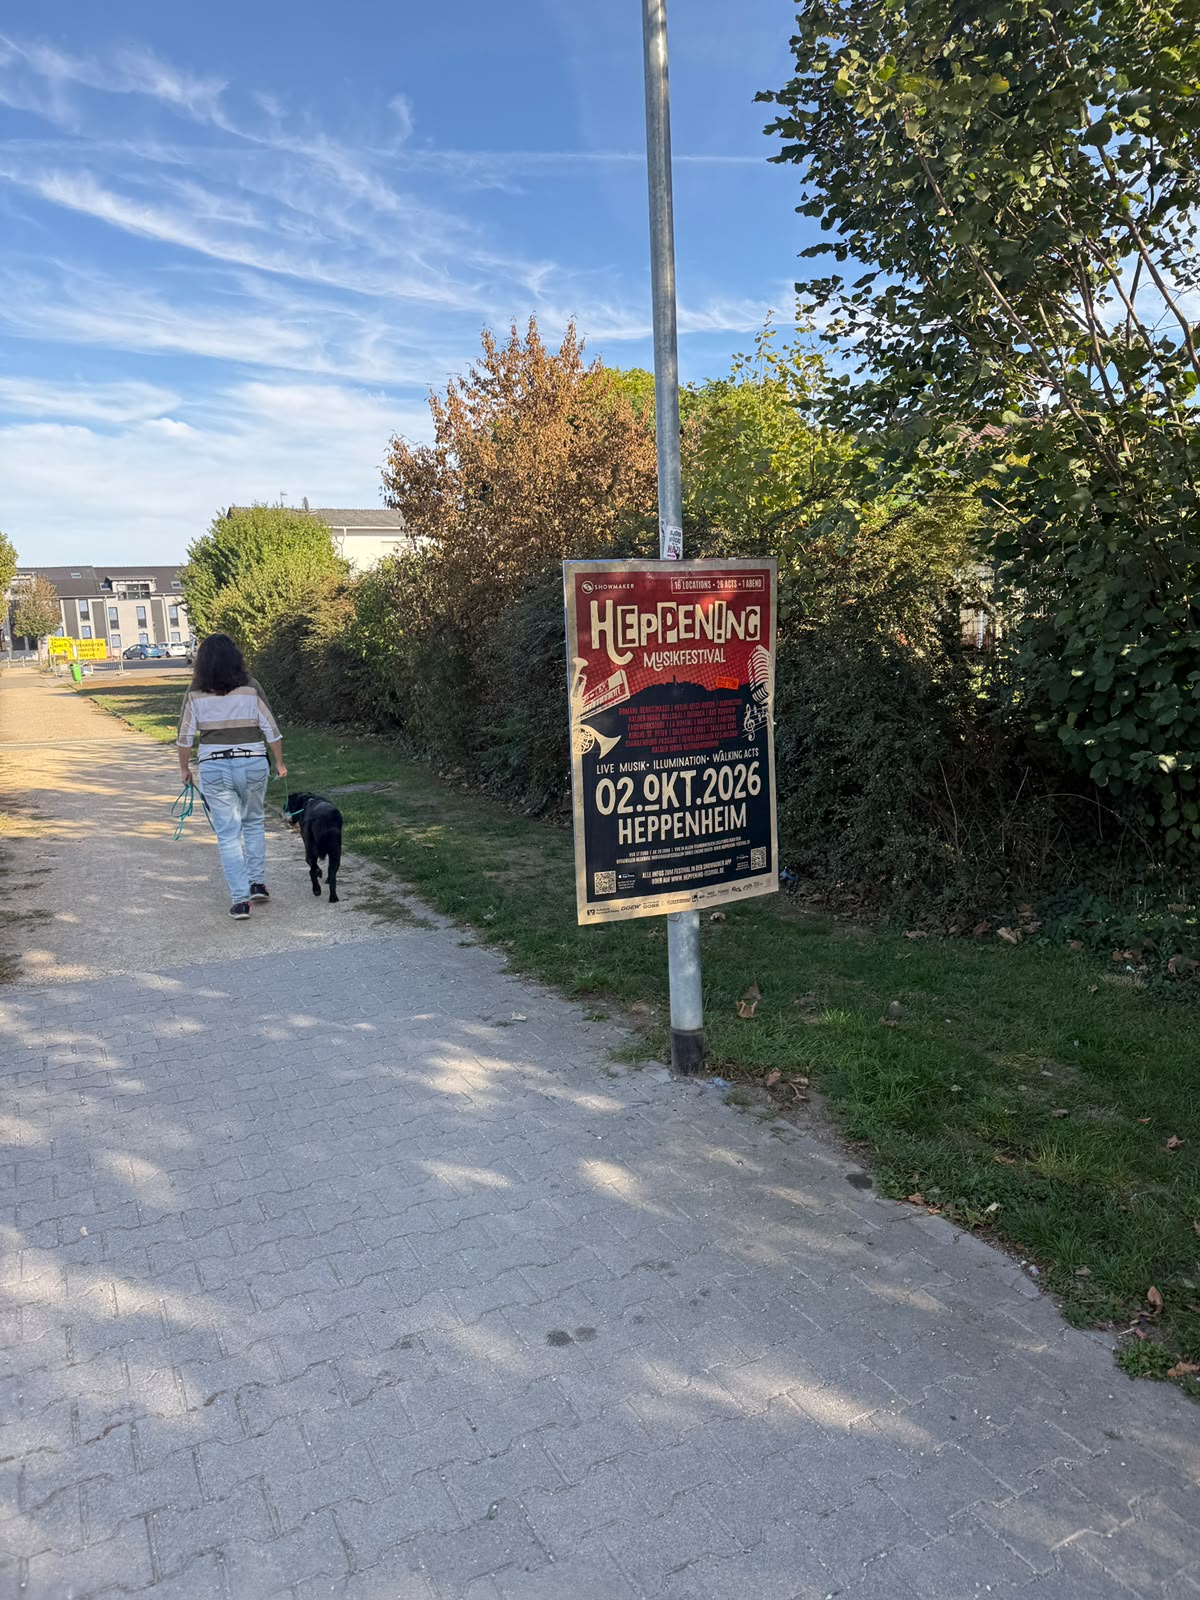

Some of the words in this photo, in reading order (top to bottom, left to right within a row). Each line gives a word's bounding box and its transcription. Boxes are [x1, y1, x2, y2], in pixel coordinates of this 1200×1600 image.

[674, 581, 681, 589] 16
[682, 580, 711, 589] LOCATIONS
[717, 580, 723, 588] 26
[724, 579, 737, 588] ACTS
[746, 579, 762, 588] ABEND
[596, 763, 615, 775] LIVE
[653, 755, 706, 770] ILLUMINATION
[712, 749, 743, 763] WALKING
[743, 747, 760, 758] ACTS
[618, 802, 747, 845] HEPPENHEIM
